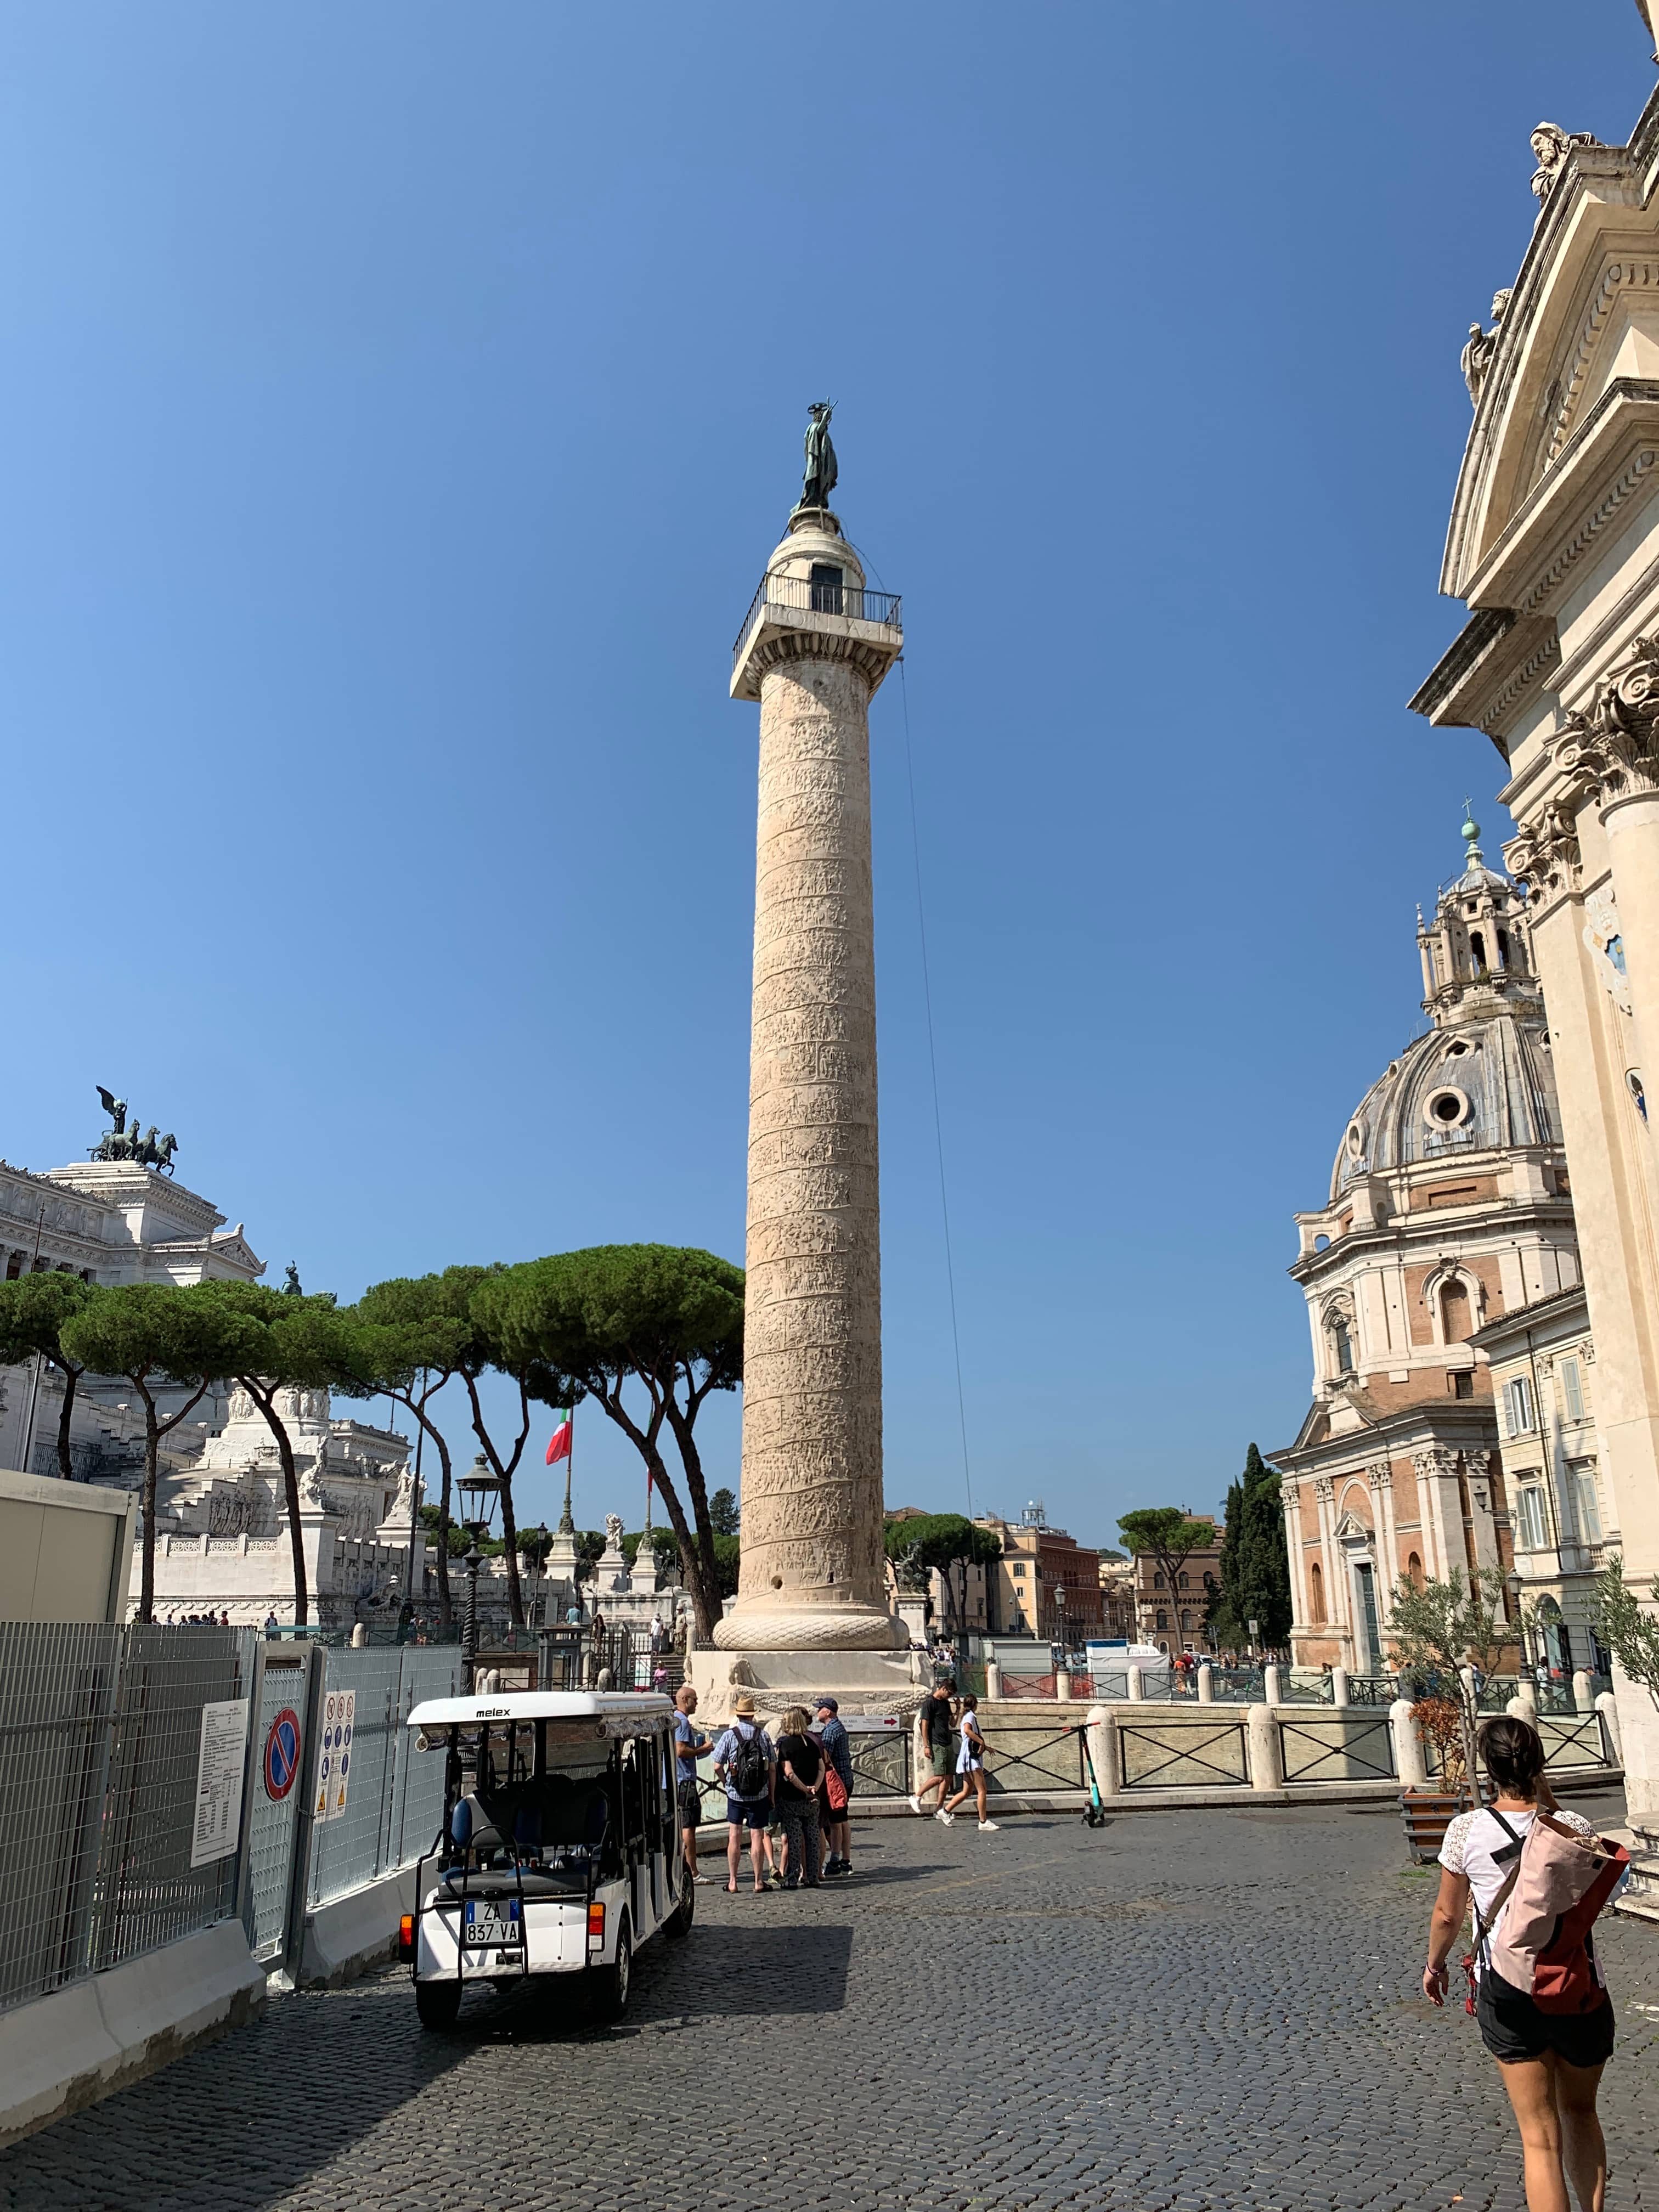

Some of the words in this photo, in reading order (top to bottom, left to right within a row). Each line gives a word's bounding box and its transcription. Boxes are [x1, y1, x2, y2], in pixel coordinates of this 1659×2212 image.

[476, 1708, 510, 1718] melex
[484, 1903, 500, 1920] ZA
[468, 1924, 494, 1941] 837
[500, 1923, 517, 1940] VA
